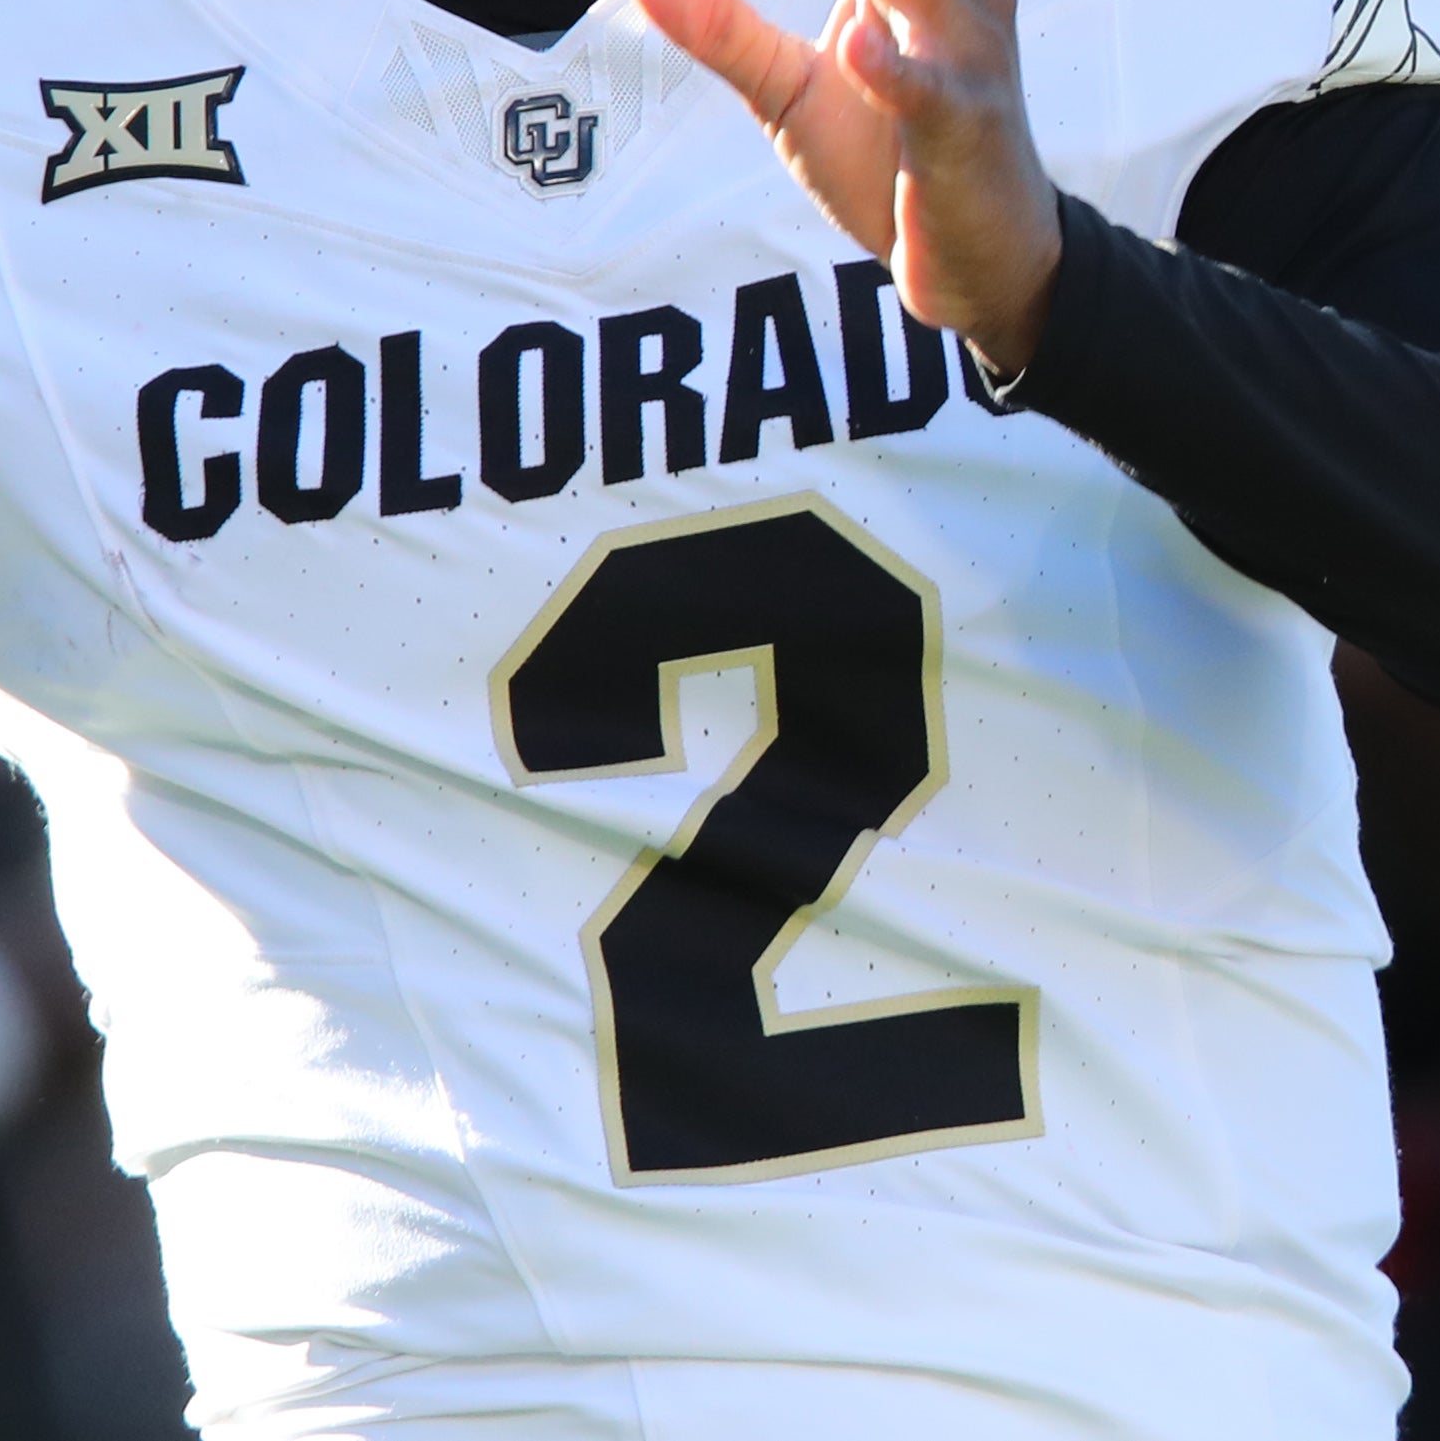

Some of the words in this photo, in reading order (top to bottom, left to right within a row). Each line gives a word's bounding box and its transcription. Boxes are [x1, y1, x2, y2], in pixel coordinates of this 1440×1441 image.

[47, 70, 235, 190] XII
[504, 93, 599, 187] CU
[137, 258, 1027, 543] COLORAD
[487, 490, 1046, 1188] 2
